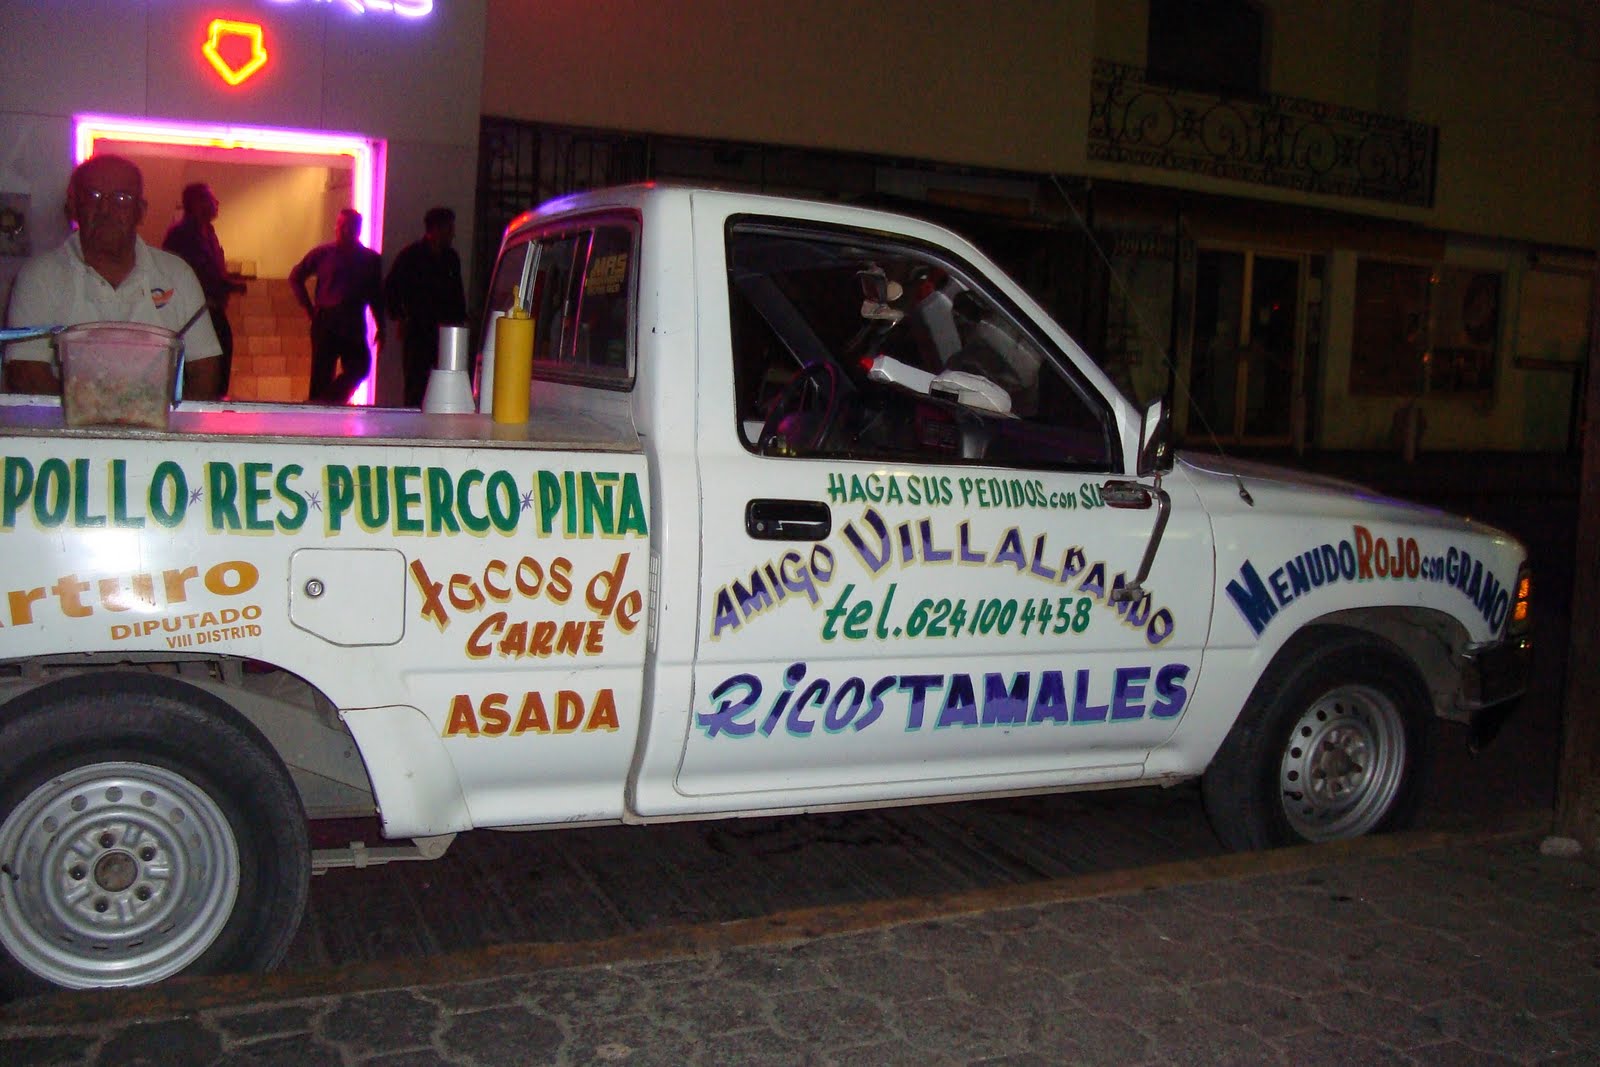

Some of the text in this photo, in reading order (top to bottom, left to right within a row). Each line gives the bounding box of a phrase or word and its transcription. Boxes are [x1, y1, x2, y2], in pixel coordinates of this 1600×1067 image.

[0, 456, 649, 539] POLLO RES PUERCO PIÑA
[828, 472, 900, 504] HAGA
[907, 474, 953, 506] SUS
[958, 476, 1049, 508] PEDIDOS
[1049, 491, 1077, 509] con
[0, 560, 260, 628] rturo
[584, 552, 644, 634] de
[710, 504, 1177, 649] AMIGO VILLALPANDO
[1225, 524, 1509, 640] MENUDO ROJO con GRANO
[110, 604, 263, 641] DIPUTADO
[166, 624, 263, 650] VIII DISTRITO
[465, 611, 605, 660] CARNE
[821, 583, 903, 642] tel.
[442, 688, 620, 738] ASADA
[896, 664, 1191, 733] TAMALES
